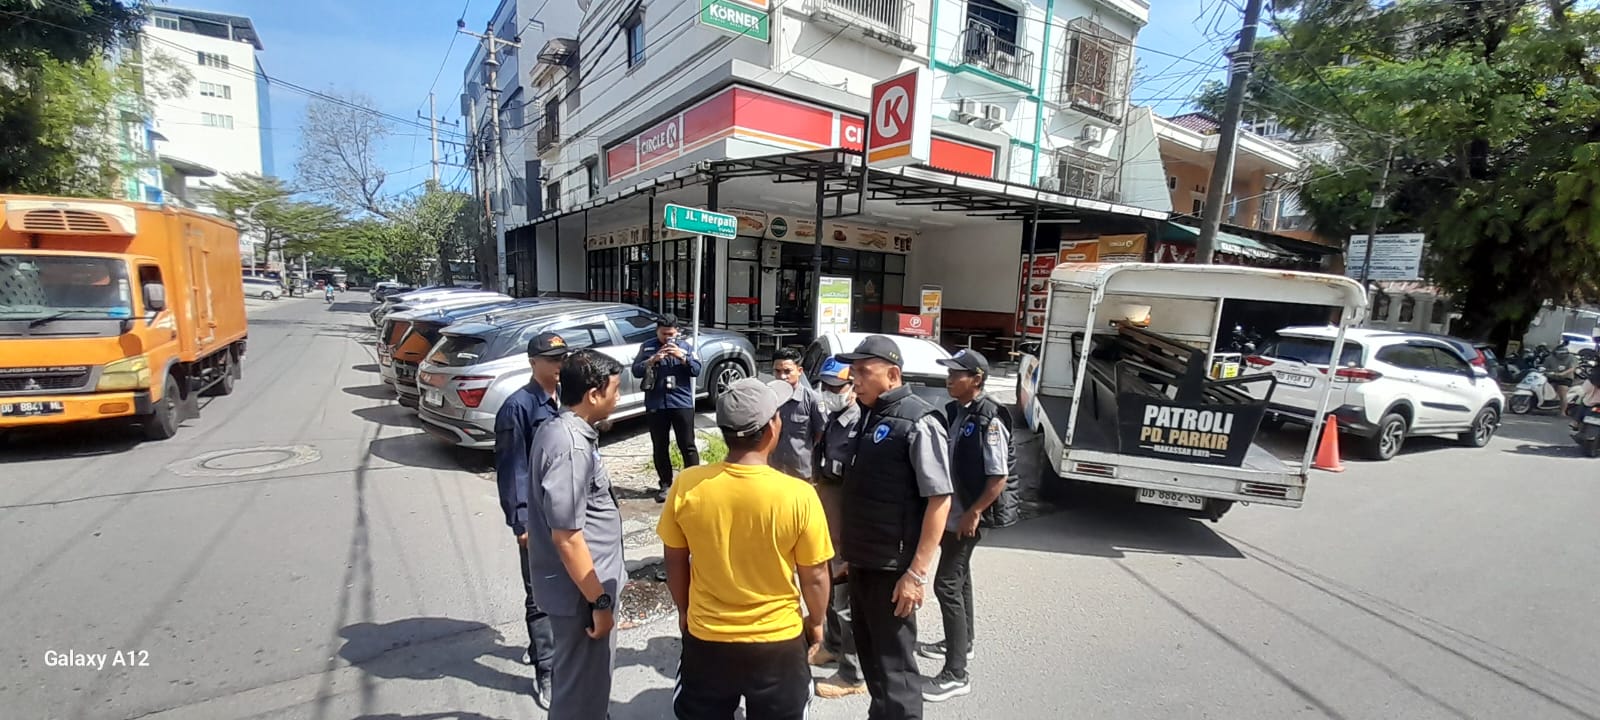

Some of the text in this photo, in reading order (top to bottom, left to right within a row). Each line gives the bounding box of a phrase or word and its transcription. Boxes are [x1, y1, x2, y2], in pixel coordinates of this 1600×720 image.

[709, 4, 759, 30] KÖRNER
[880, 92, 906, 132] K
[641, 123, 677, 155] CIRCLE K
[845, 125, 863, 143] CI
[685, 210, 698, 222] JL.
[1143, 405, 1234, 434] PATROLI
[1140, 426, 1229, 450] PD. PARKIR
[1153, 444, 1192, 456] MAKASSAR
[1142, 488, 1155, 498] DD
